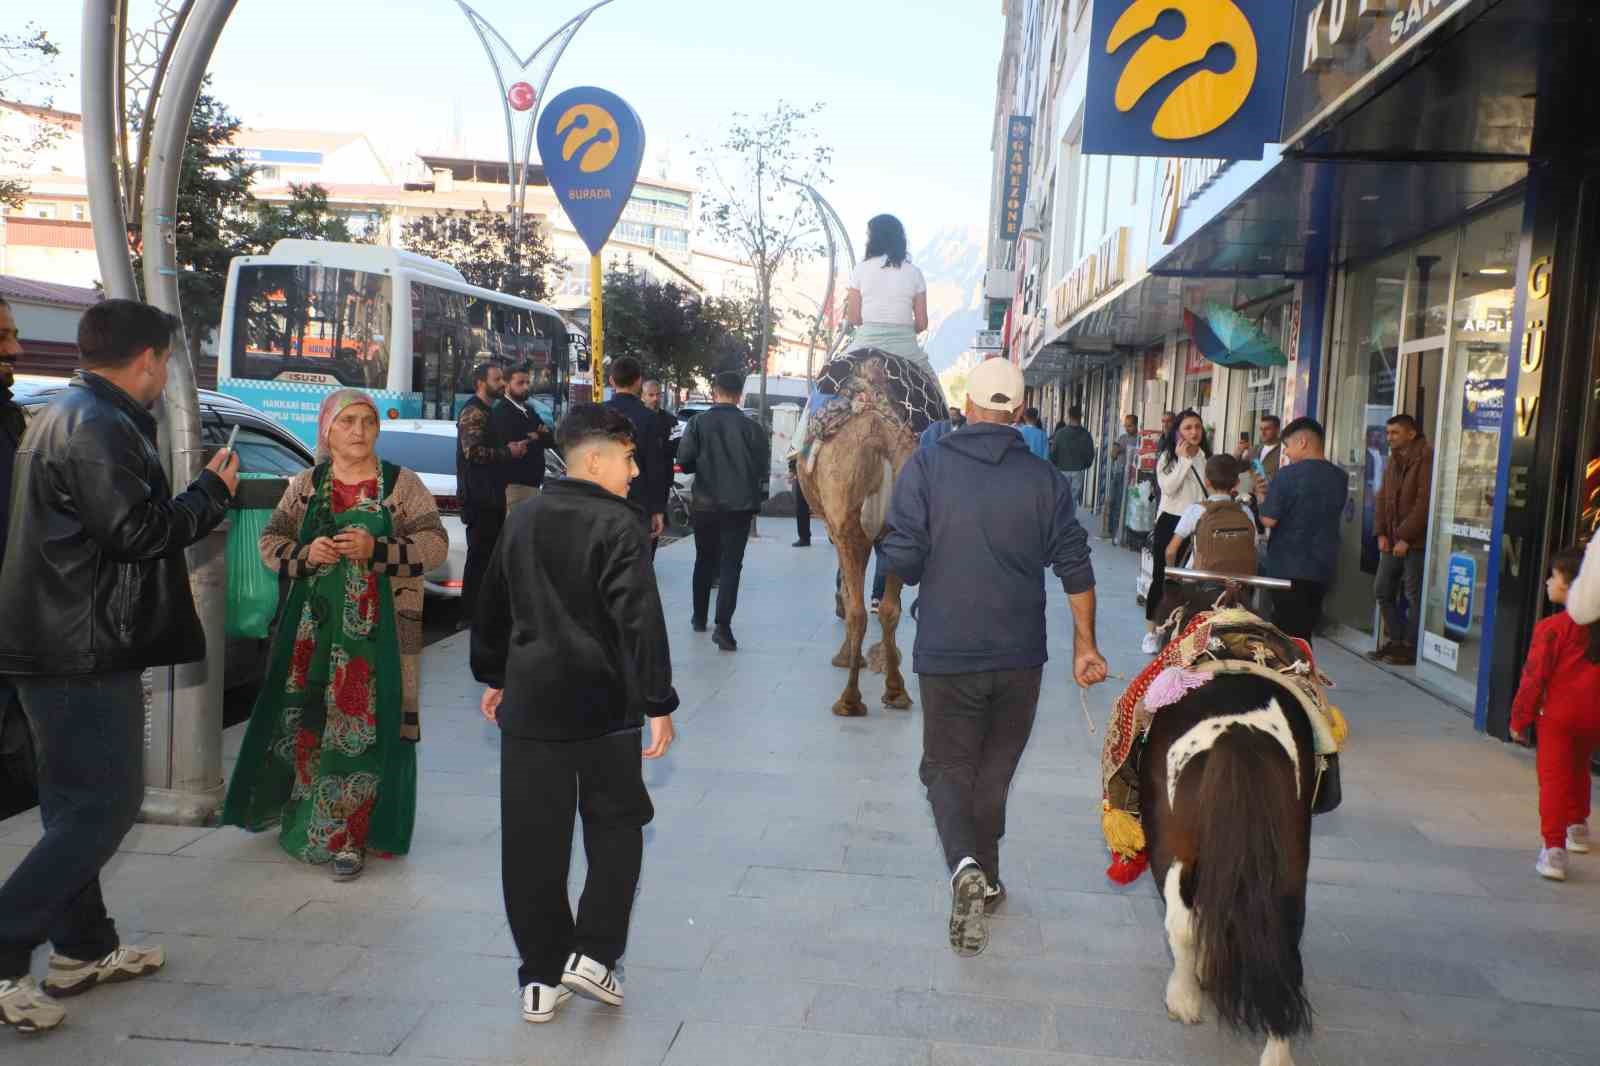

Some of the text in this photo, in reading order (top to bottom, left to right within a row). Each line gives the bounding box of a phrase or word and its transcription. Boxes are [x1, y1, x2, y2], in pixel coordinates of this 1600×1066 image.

[568, 187, 612, 201] BURADA
[1007, 140, 1025, 233] GAMEZONE
[287, 373, 327, 383] ISUZU
[1503, 255, 1551, 577] GÜVEN
